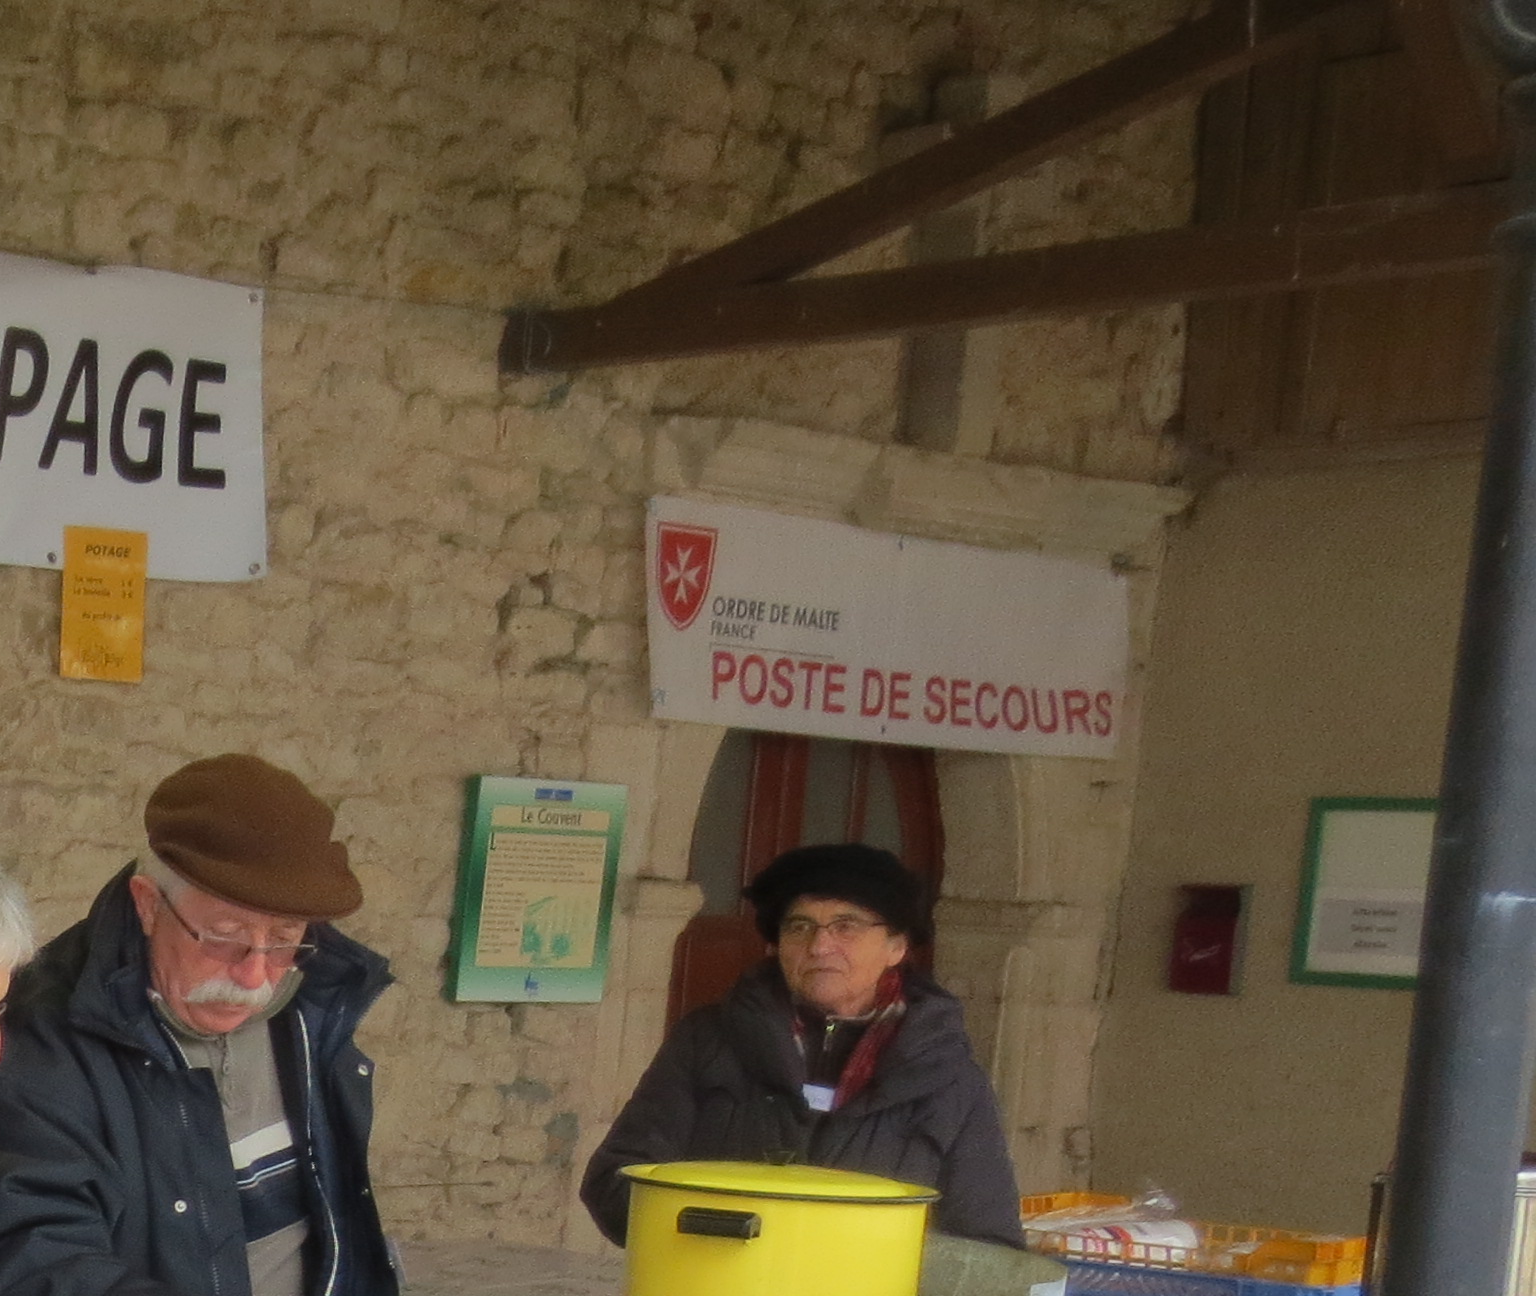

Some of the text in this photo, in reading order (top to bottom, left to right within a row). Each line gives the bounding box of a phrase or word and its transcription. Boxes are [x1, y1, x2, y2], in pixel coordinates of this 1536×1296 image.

[85, 544, 131, 558] POTAGE
[712, 596, 840, 631] ORDRE DE MALTE
[710, 623, 757, 641] FRANCE
[711, 649, 1113, 737] POSTE DE SECOURS
[521, 806, 582, 826] Le Couvent
